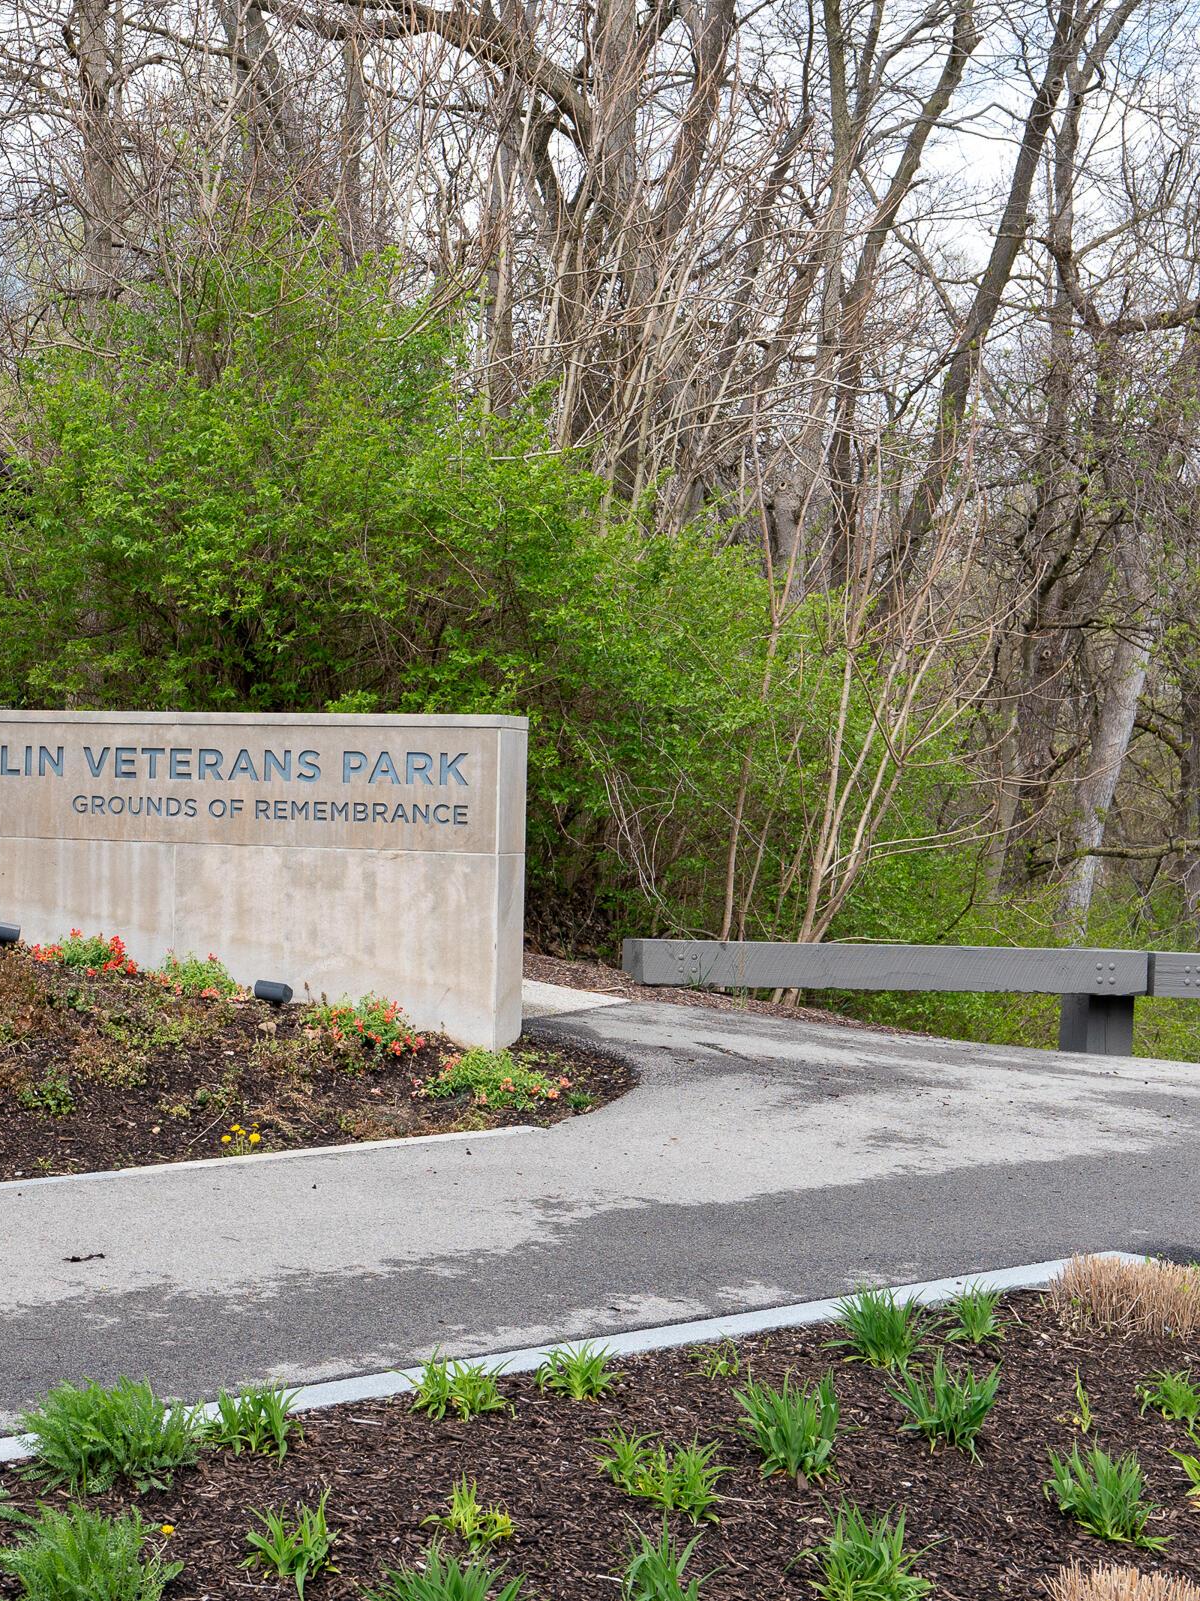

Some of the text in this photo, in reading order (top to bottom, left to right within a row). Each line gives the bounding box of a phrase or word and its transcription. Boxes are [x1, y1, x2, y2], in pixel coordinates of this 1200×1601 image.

[82, 746, 322, 783] VETERANS
[342, 750, 470, 786] PARK
[72, 794, 470, 825] GROUNDS OF REMEMBRANCE
